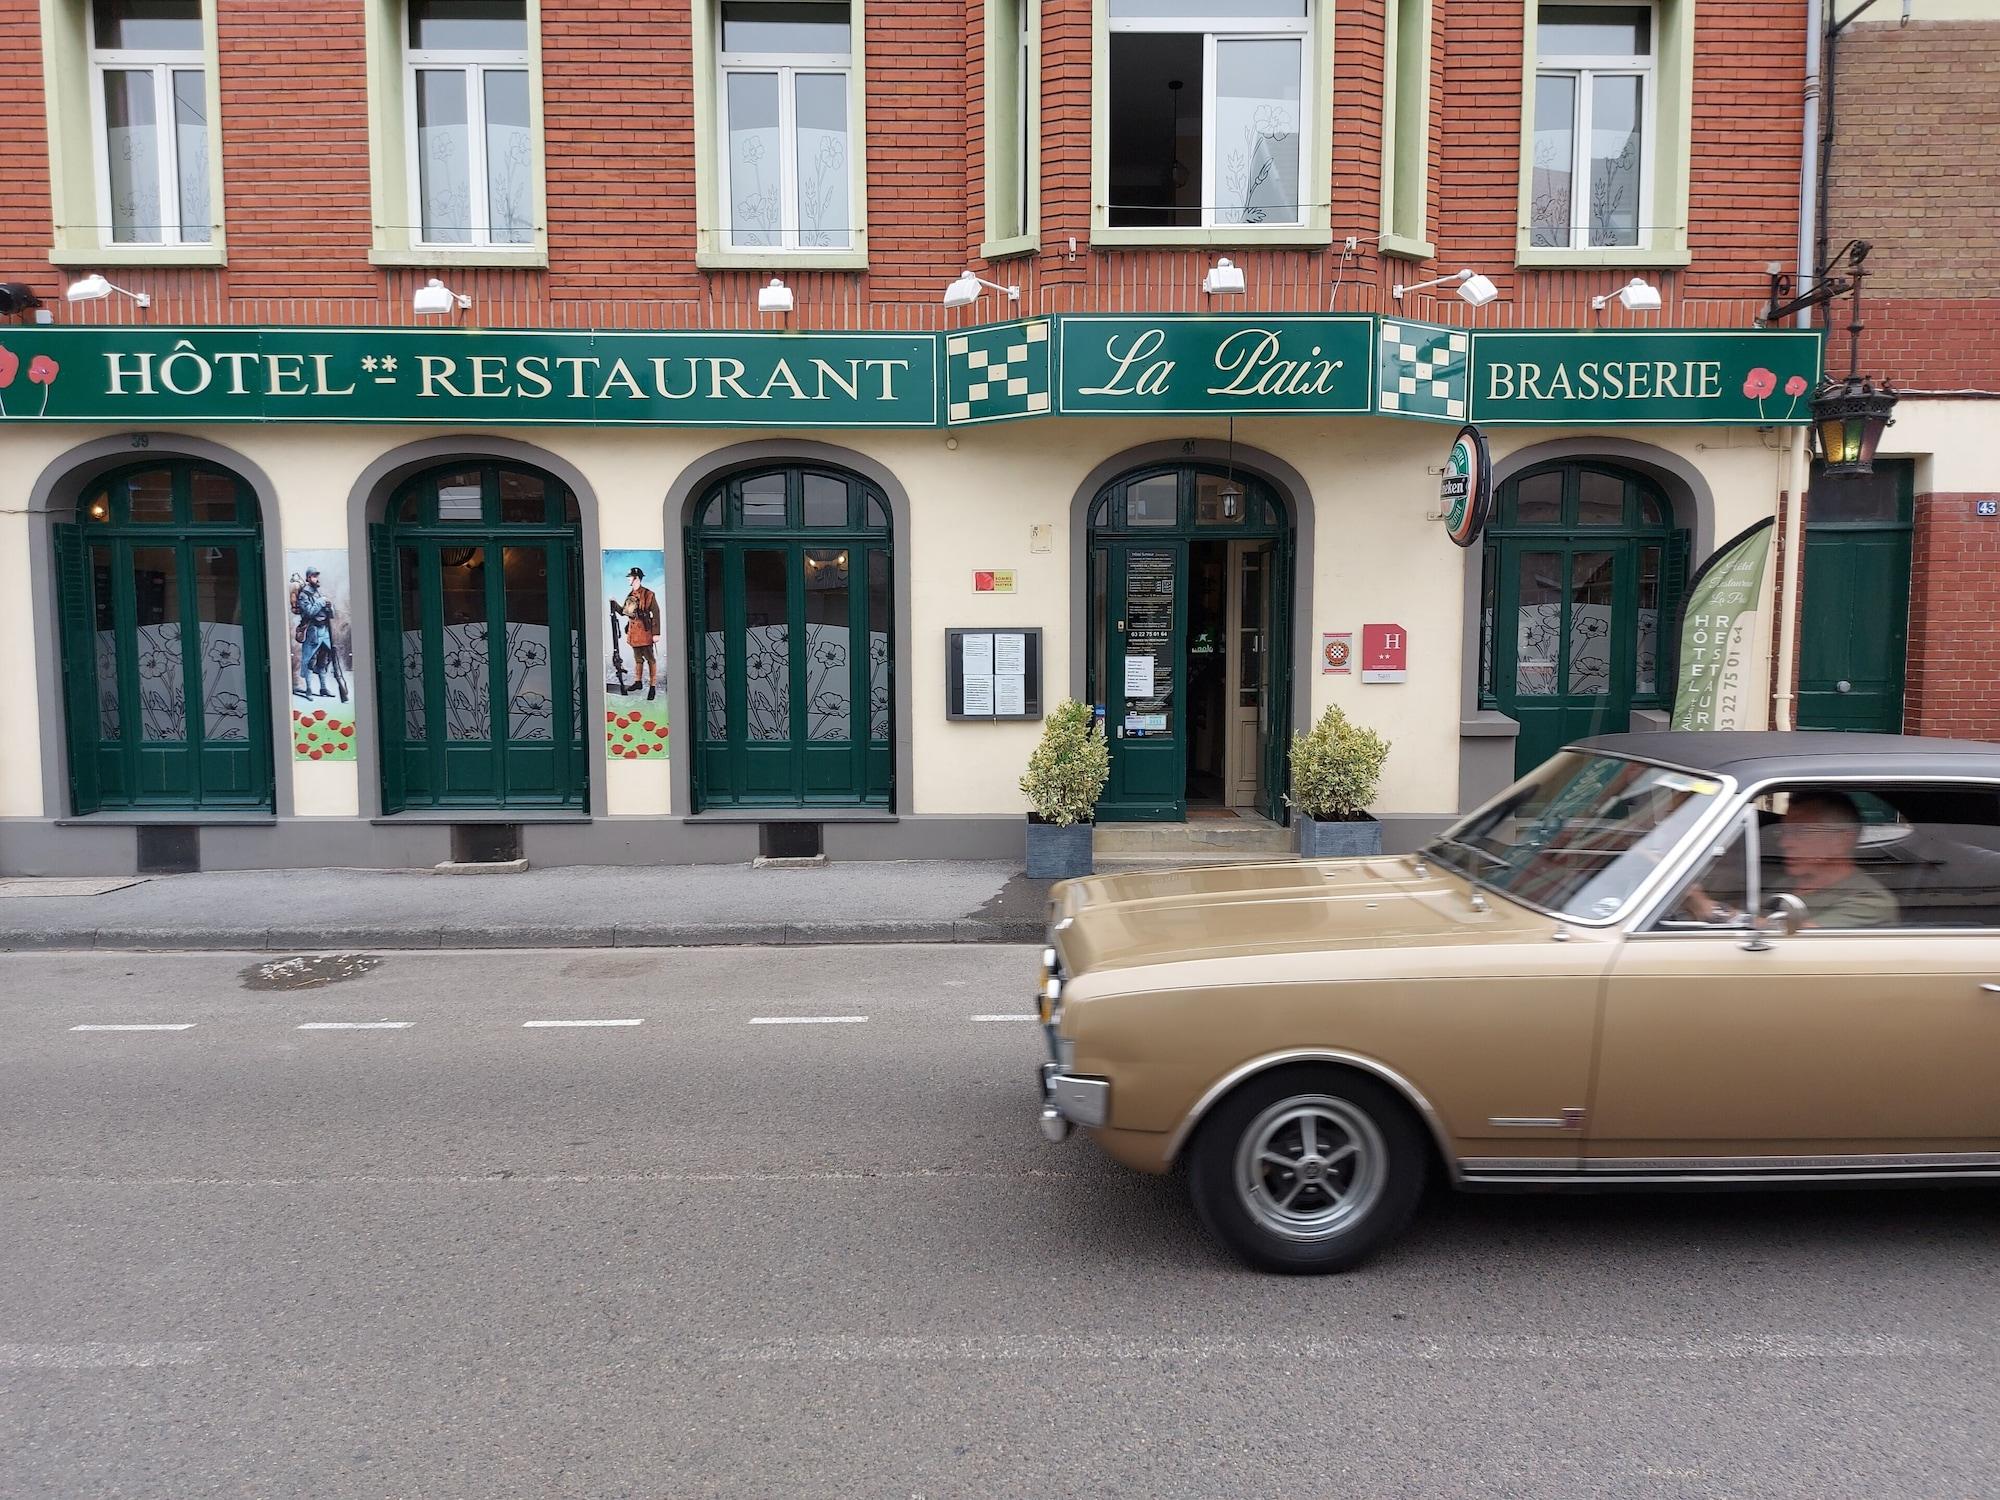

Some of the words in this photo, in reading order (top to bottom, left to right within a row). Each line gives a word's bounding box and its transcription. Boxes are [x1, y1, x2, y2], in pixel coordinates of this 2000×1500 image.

[103, 339, 356, 395] HÔTEL
[414, 355, 909, 401] RESTAURANT
[1078, 329, 1176, 396] La
[1206, 328, 1343, 396] Paix
[1486, 361, 1723, 400] BRASSERIE
[1979, 502, 1996, 514] 43
[1384, 633, 1401, 650] H
[1733, 625, 1743, 644] 64
[1688, 615, 1710, 692] HÔTEL
[1727, 651, 1740, 667] 01
[1697, 615, 1730, 731] RESTAUR
[1724, 672, 1738, 690] 75
[1722, 695, 1736, 713] 22
